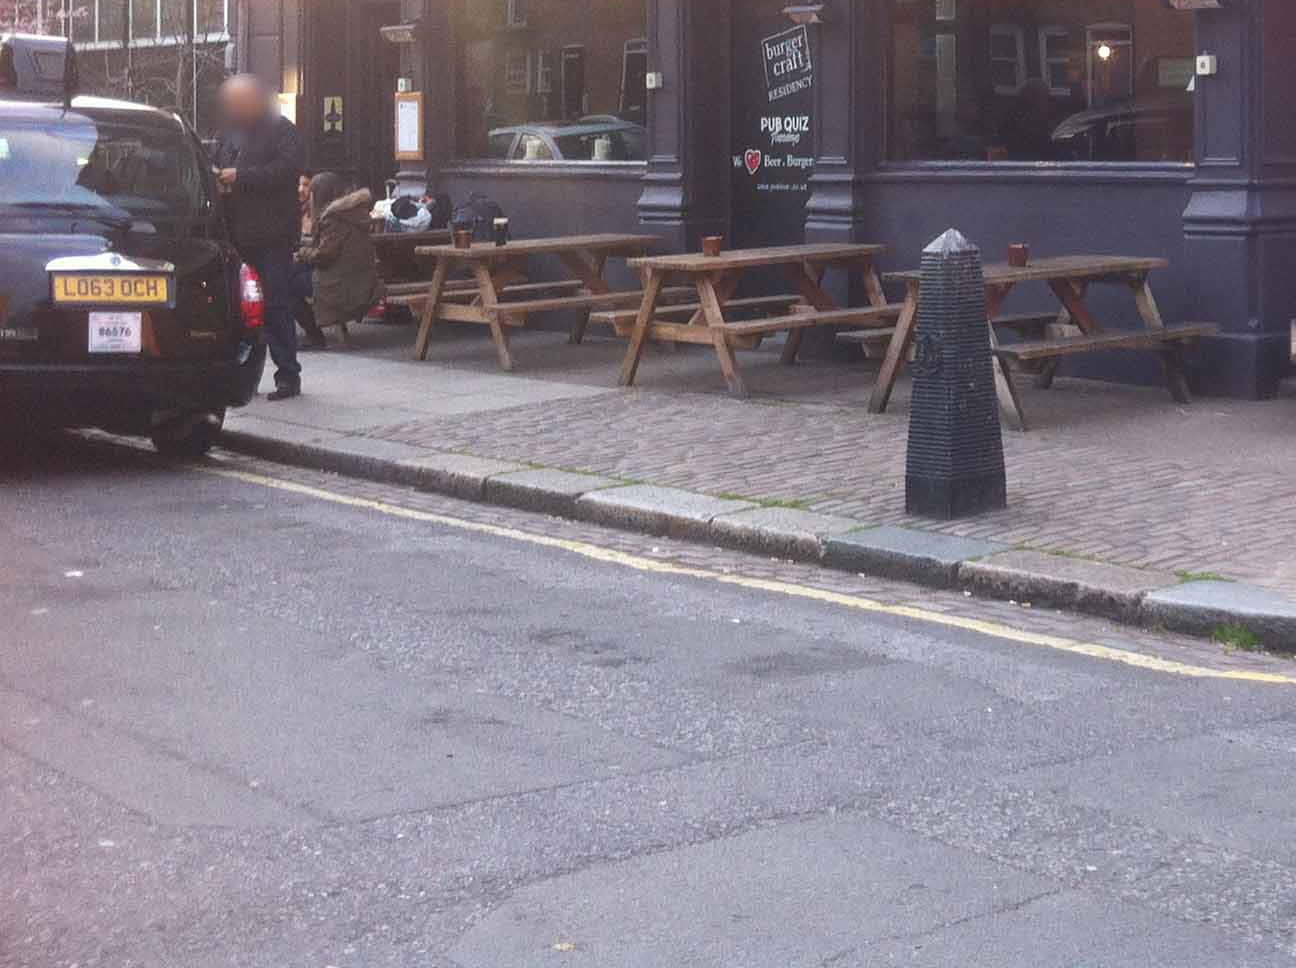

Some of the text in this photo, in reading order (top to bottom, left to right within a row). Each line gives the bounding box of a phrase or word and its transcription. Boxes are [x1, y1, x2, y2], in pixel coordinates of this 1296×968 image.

[765, 34, 803, 60] burger
[773, 51, 804, 76] craft
[760, 115, 809, 133] PUB QUIZ
[63, 278, 159, 298] LO63 OCH
